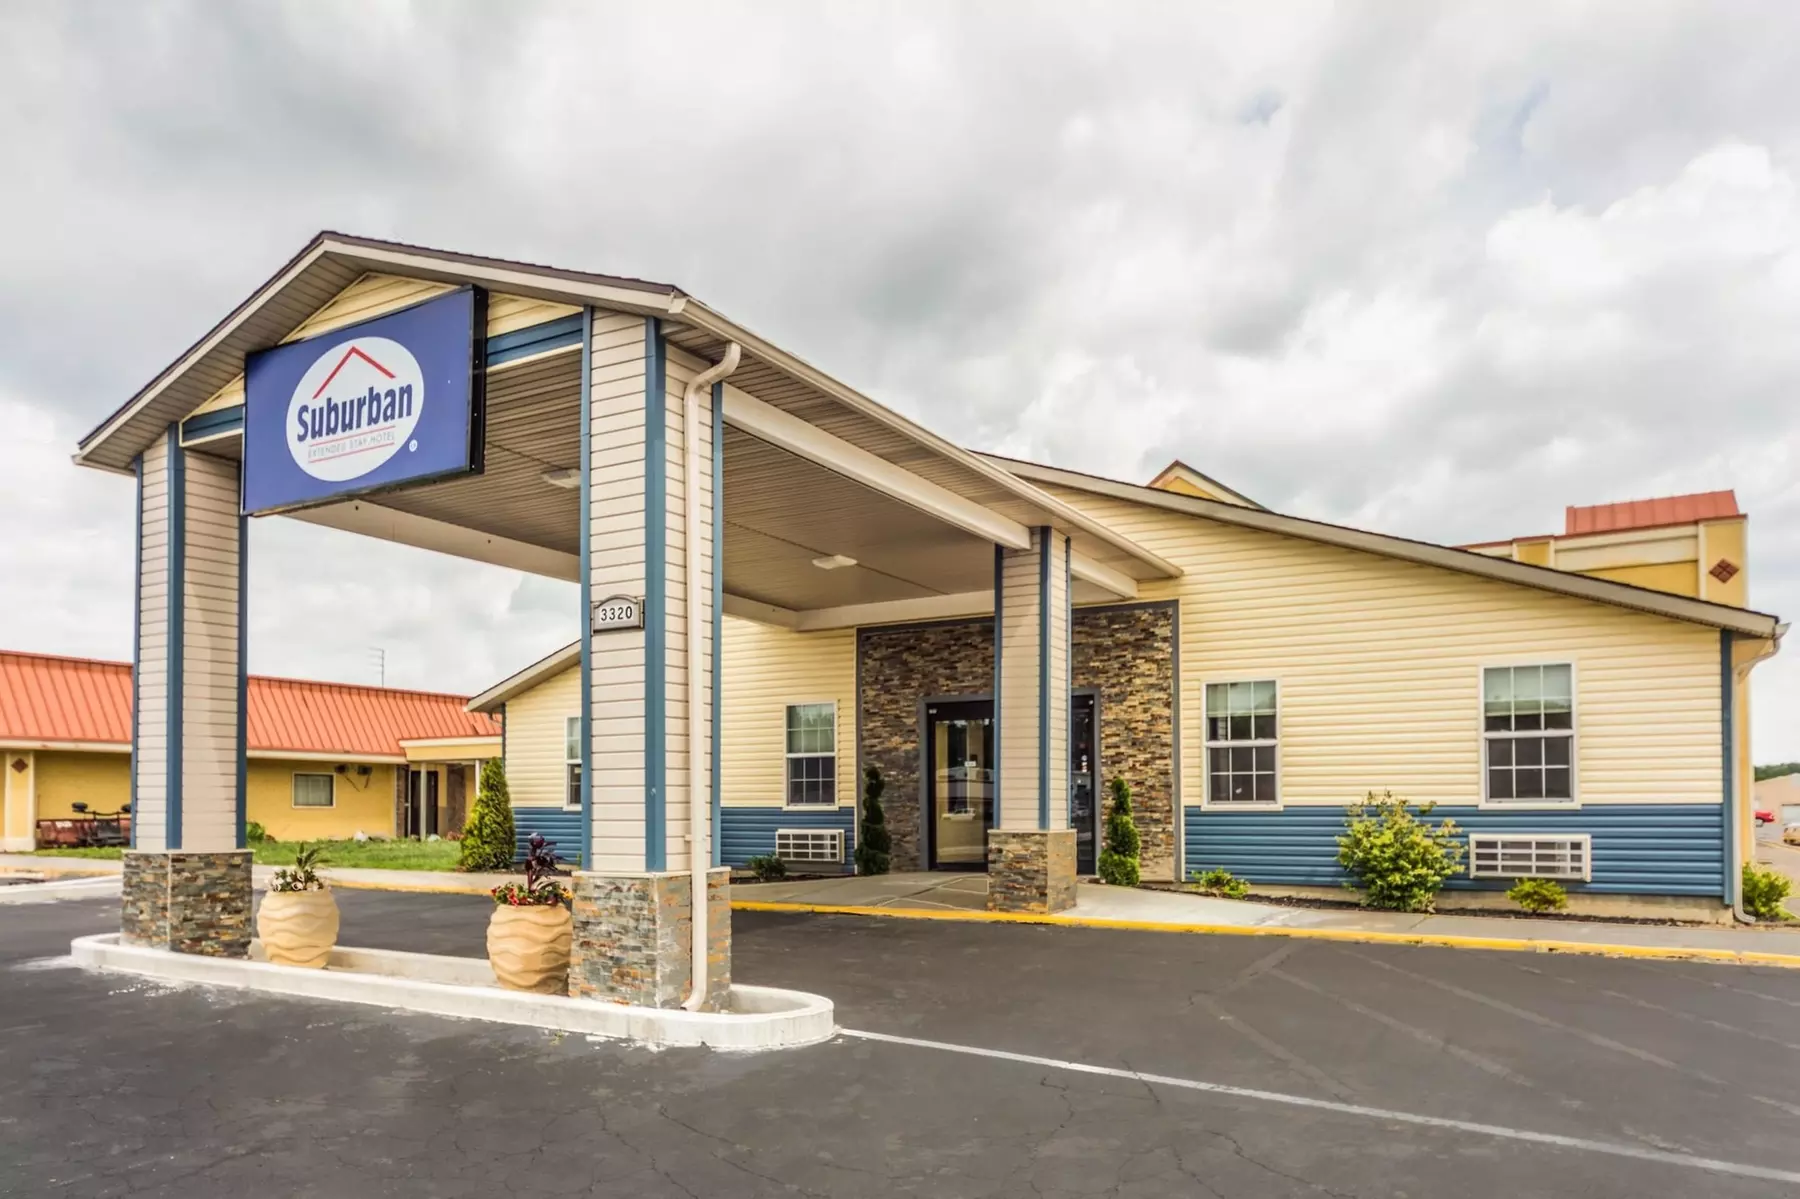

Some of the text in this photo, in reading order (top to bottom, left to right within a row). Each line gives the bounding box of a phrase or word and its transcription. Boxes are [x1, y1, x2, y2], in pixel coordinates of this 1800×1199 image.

[297, 384, 412, 442] Suburban
[370, 431, 395, 445] HOTEL
[601, 606, 632, 621] 3320
